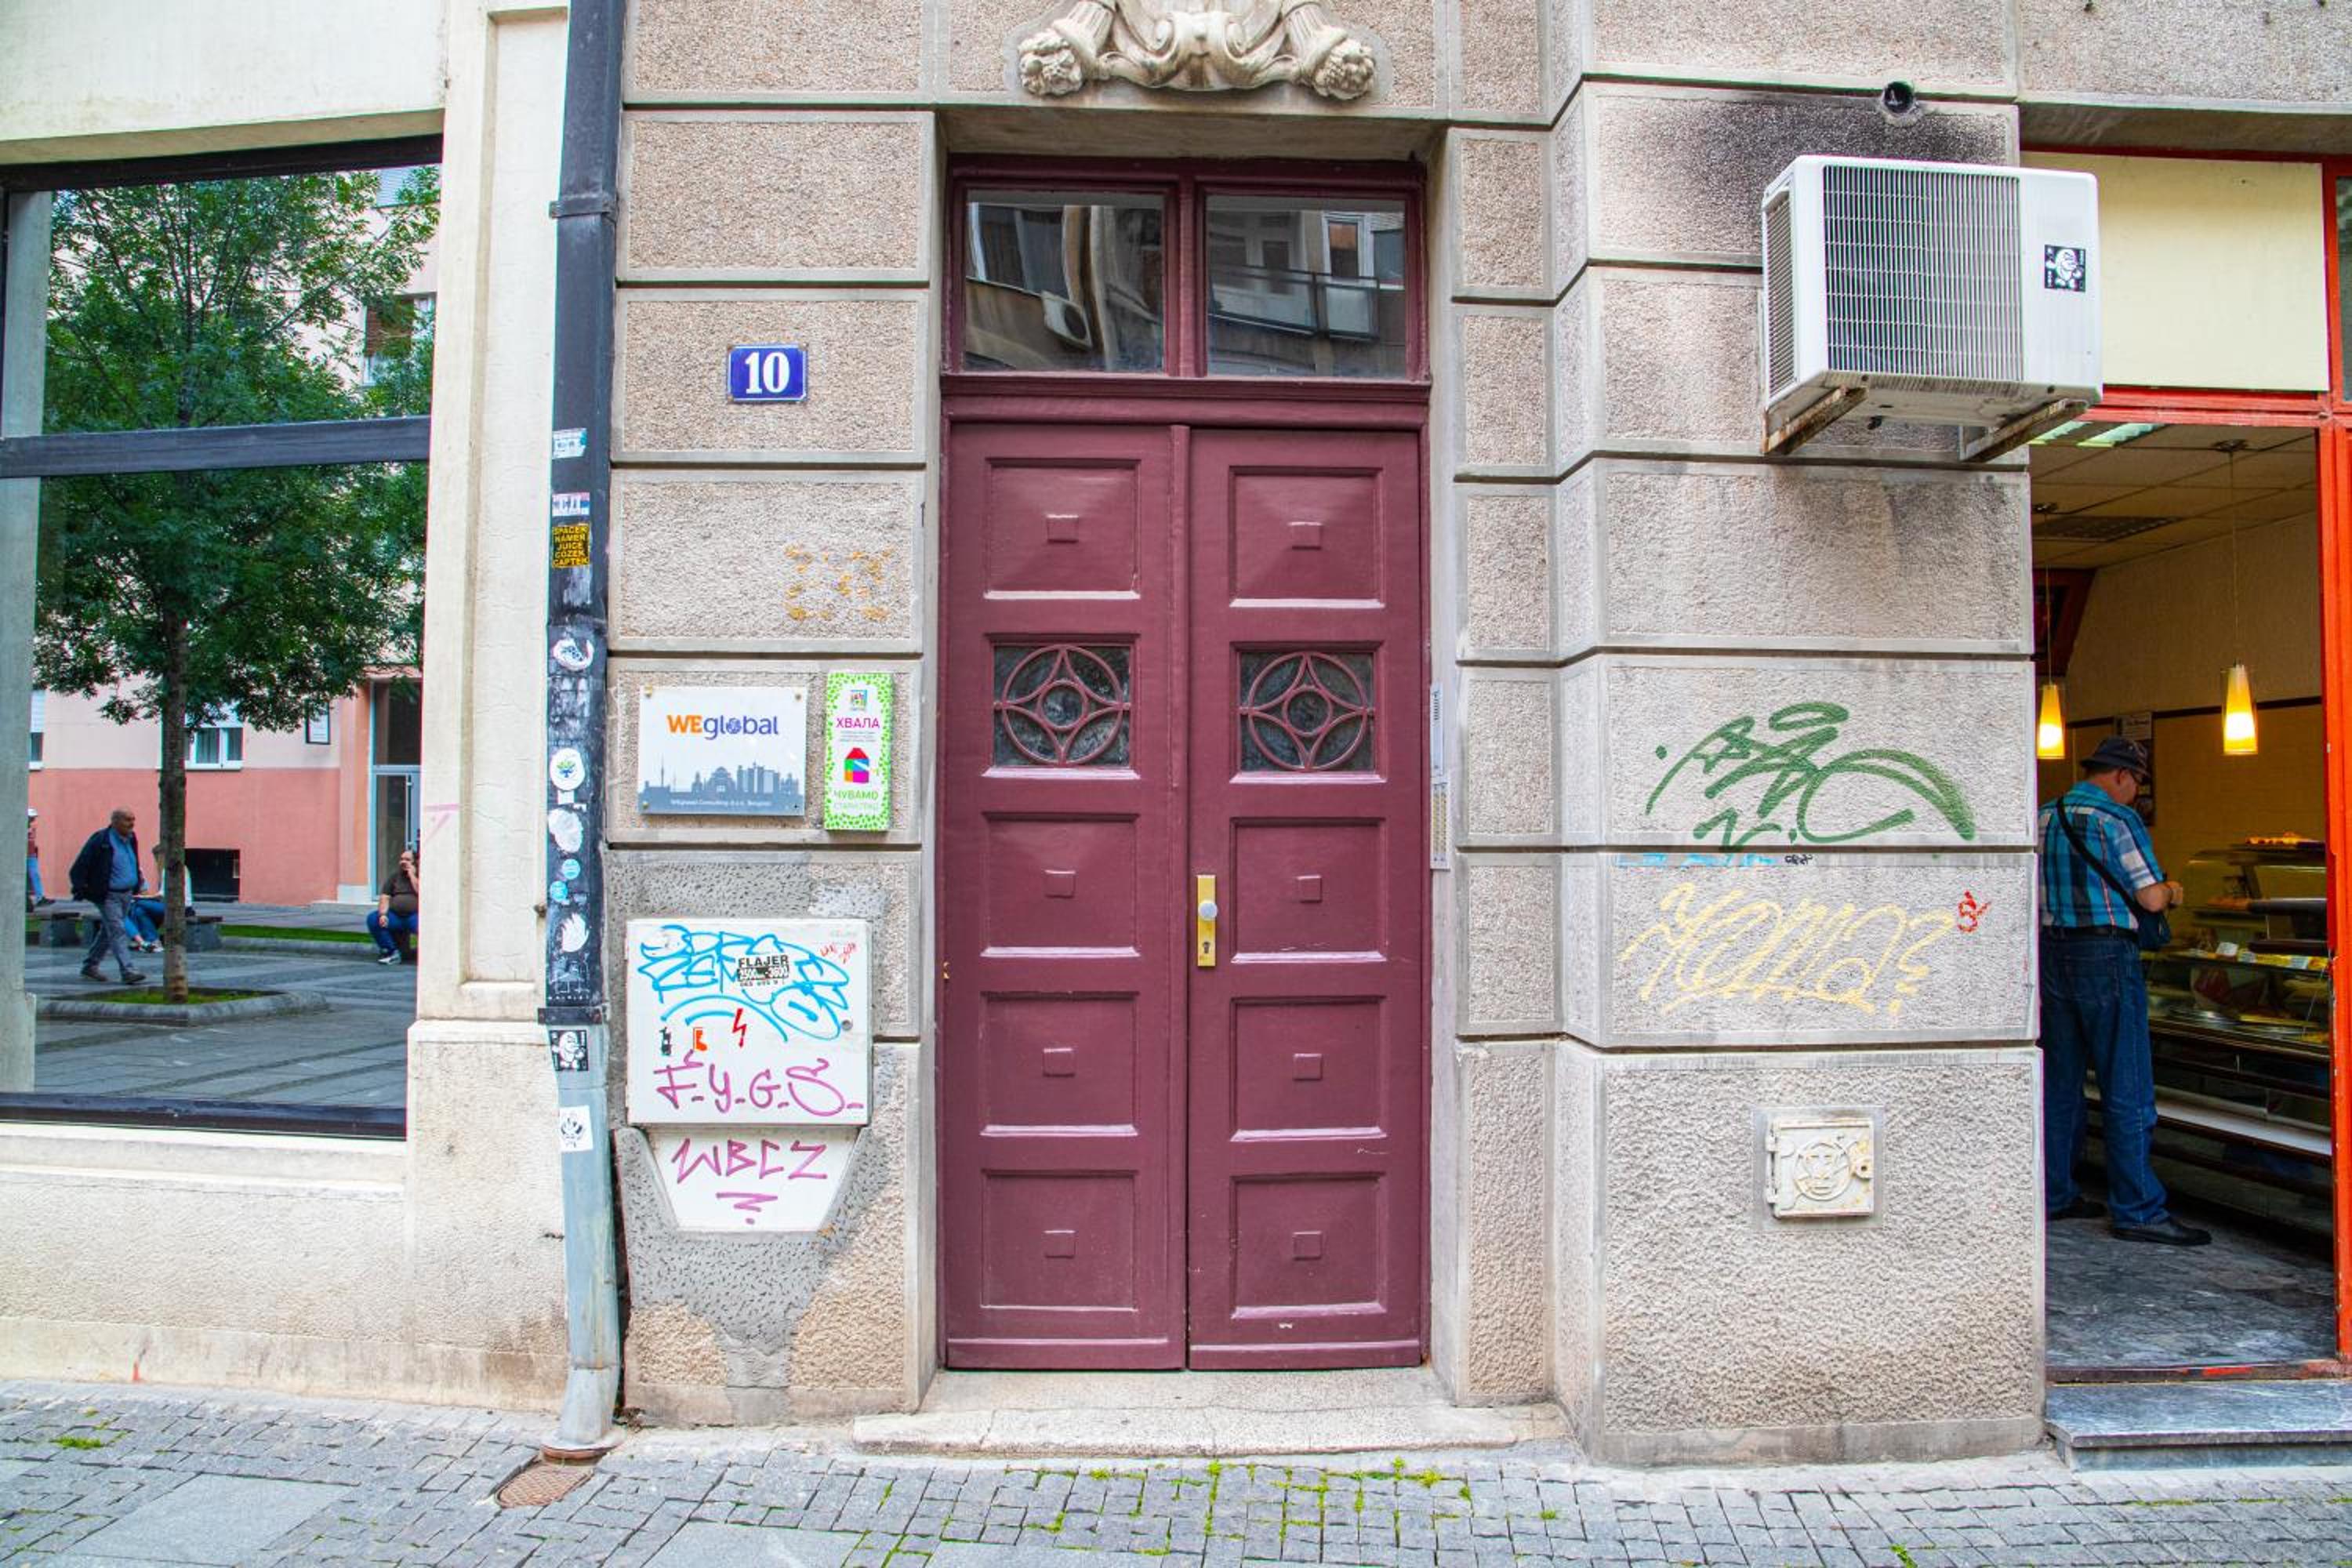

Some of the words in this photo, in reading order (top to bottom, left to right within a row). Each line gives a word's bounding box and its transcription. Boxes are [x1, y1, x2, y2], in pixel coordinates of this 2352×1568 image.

[745, 351, 790, 394] 10
[666, 714, 779, 740] WEglobal
[836, 717, 880, 728] ХВАЛА
[738, 954, 789, 968] FLAJER
